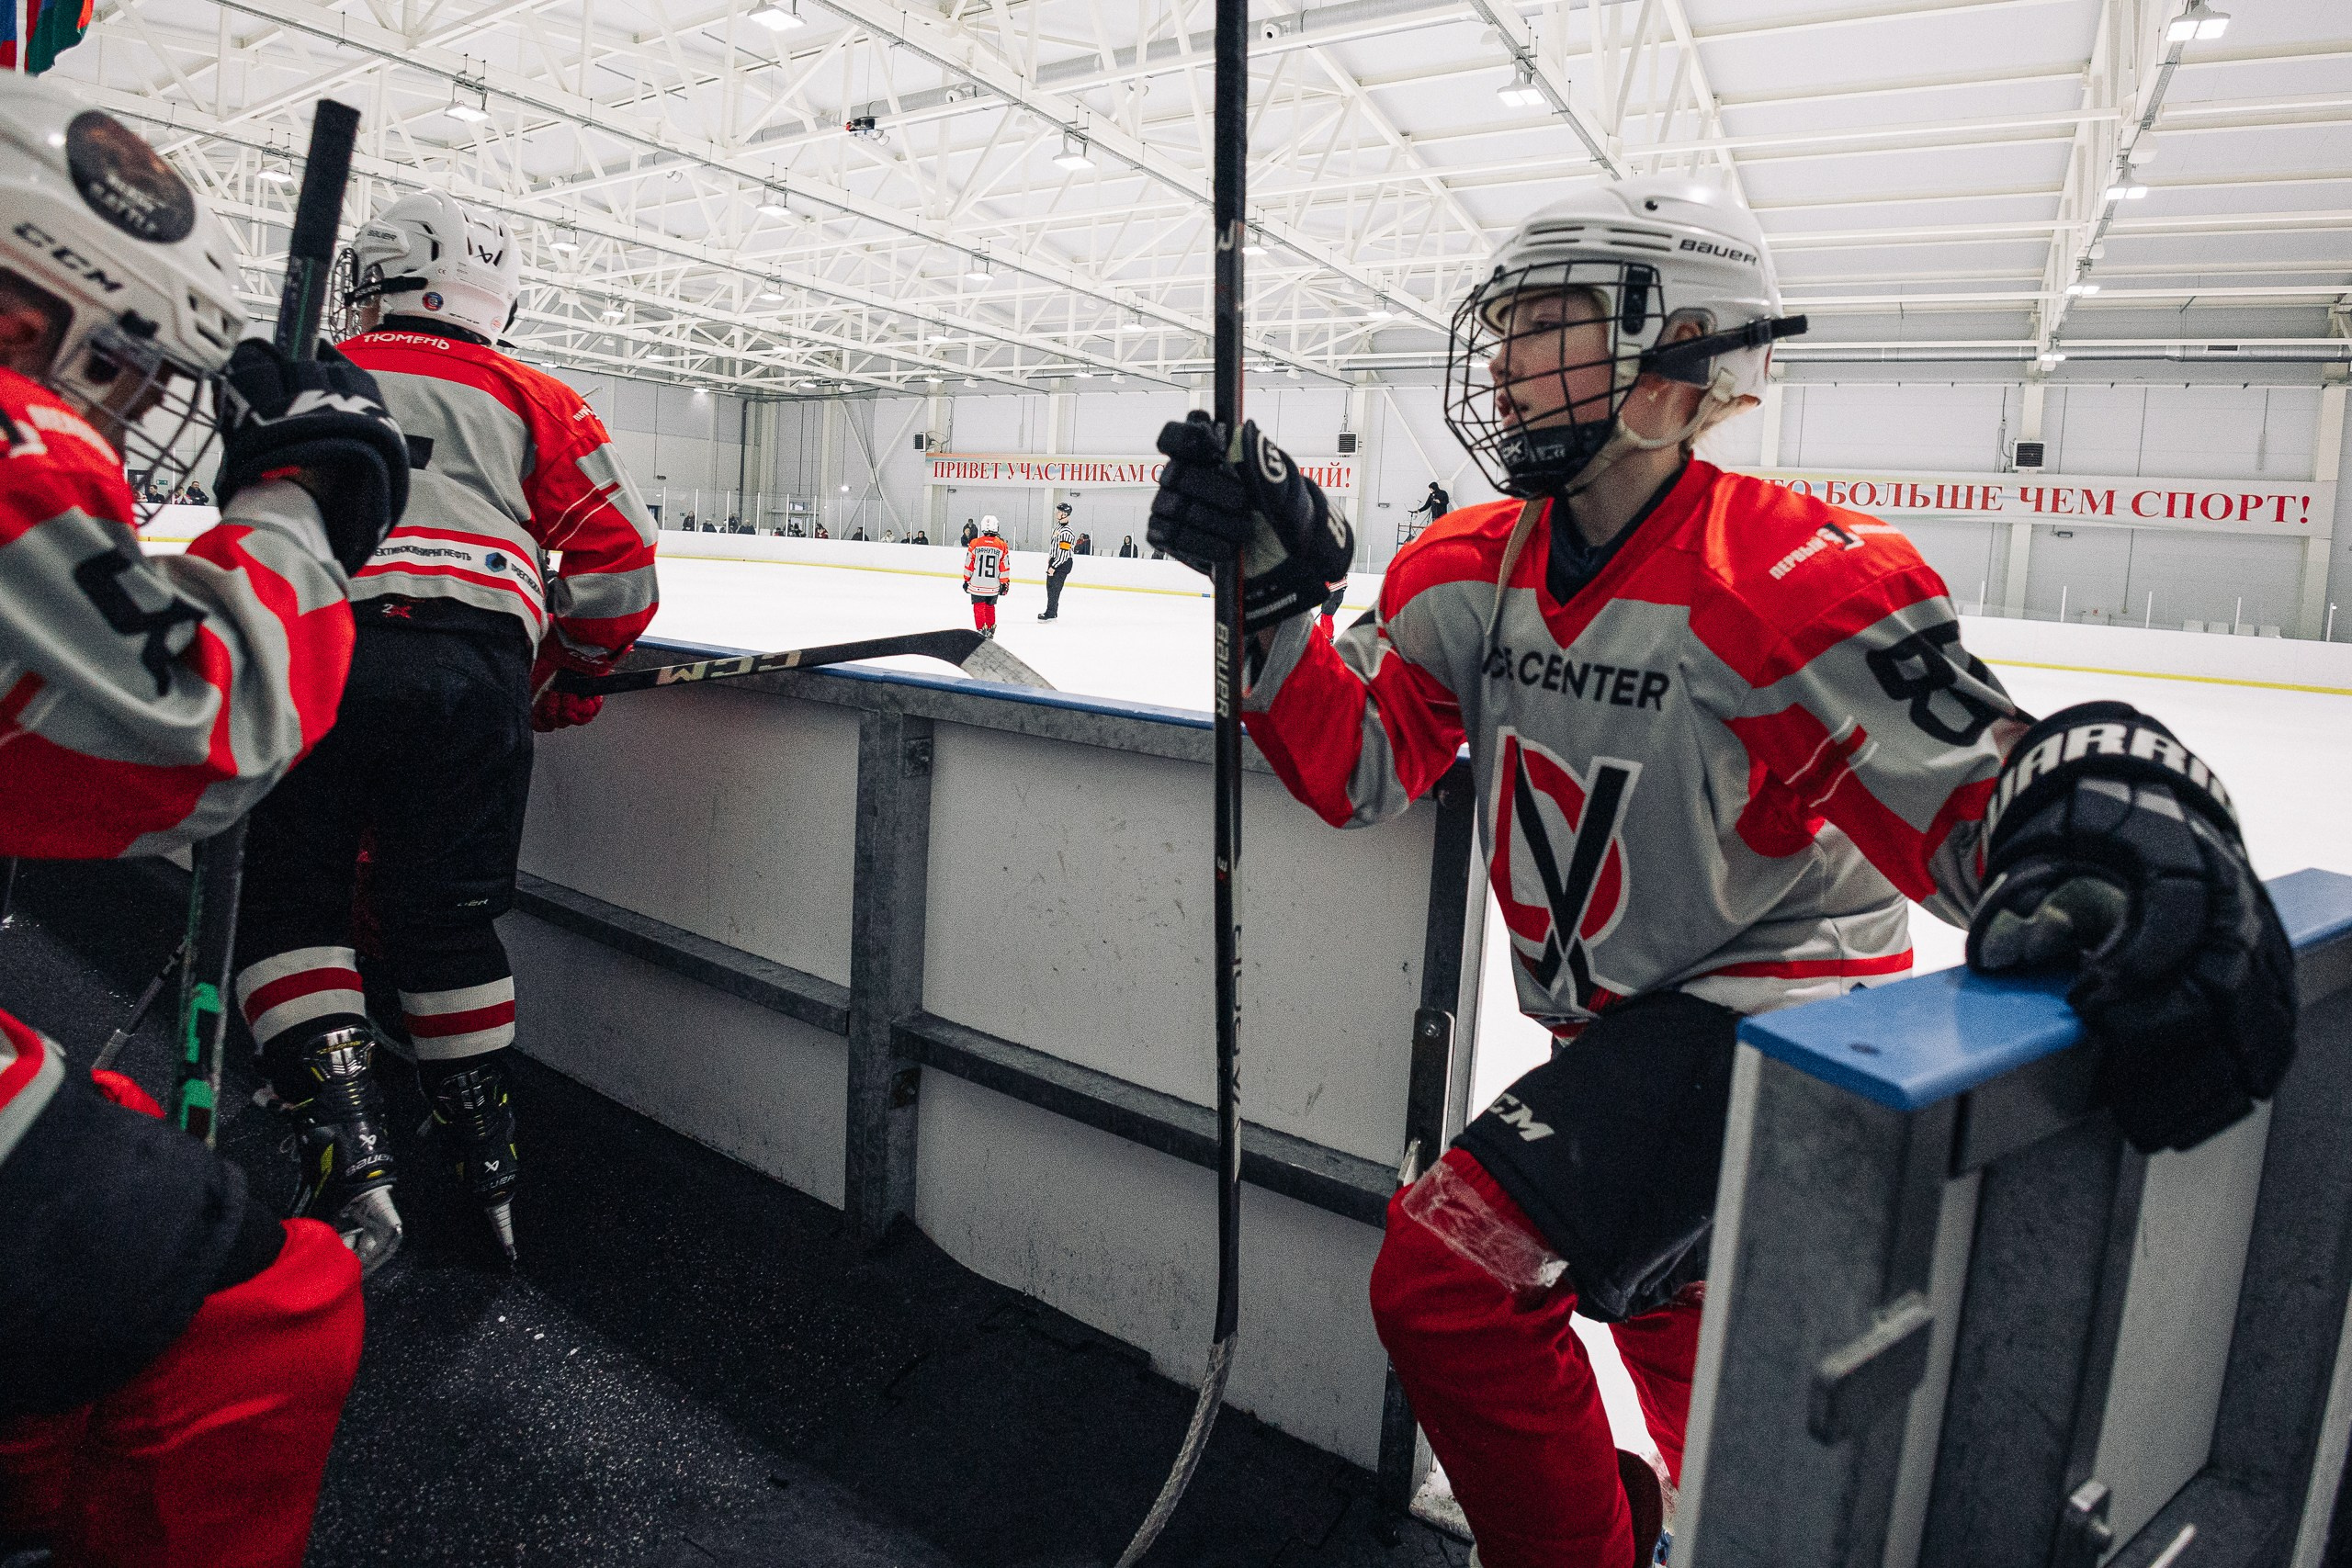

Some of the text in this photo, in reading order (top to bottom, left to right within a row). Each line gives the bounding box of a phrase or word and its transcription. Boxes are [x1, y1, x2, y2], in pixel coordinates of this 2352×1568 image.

[13, 220, 125, 294] CCM
[363, 333, 450, 350] ТЮМЕНЬ
[933, 460, 1002, 480] ПРИВЕТ
[1007, 462, 1145, 482] УЧАСТНИКАМ
[1825, 480, 2004, 511] БОЛЬШЕ
[2018, 486, 2117, 515] ЧЕМ
[2132, 490, 2310, 524] СПОРТ!
[978, 554, 996, 579] 19
[1518, 649, 1670, 712] CENTER
[1488, 1092, 1555, 1142] CM
